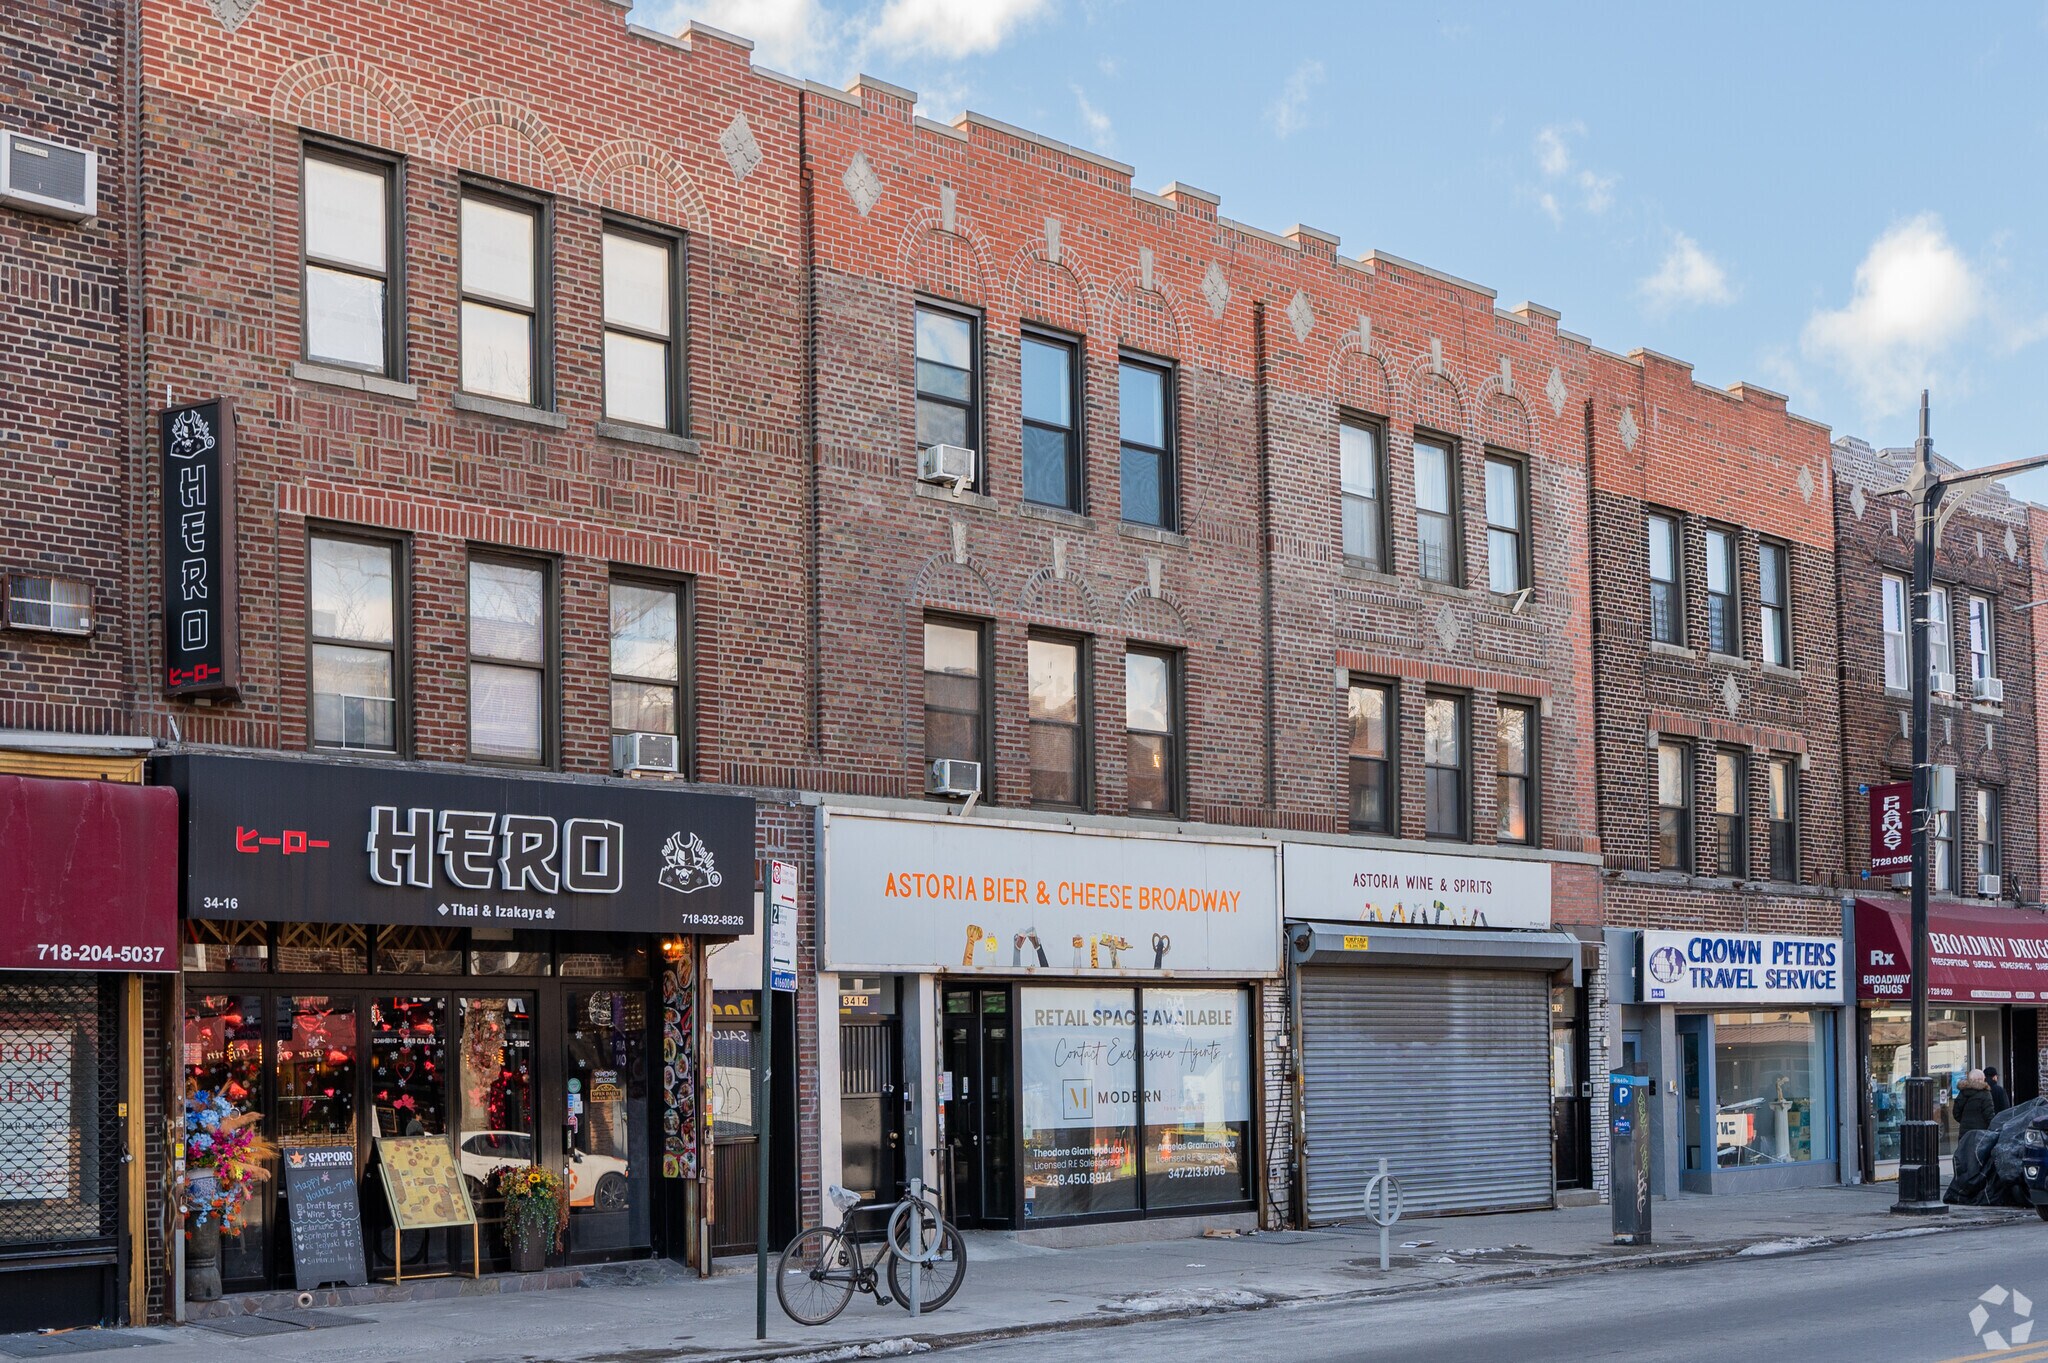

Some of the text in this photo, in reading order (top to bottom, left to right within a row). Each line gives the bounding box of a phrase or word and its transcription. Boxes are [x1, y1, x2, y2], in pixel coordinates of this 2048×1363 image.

[180, 464, 208, 652] HERO
[169, 663, 220, 685] ヒーロー
[1881, 795, 1903, 850] PHARMACY
[236, 826, 330, 855] ヒーロー
[366, 805, 624, 895] HERO
[1353, 873, 1492, 894] ASTORIA WINE & SPIRITS
[885, 872, 1241, 913] ASTORIA BIER & CHEESE BROADWAY
[203, 897, 239, 910] 34-16
[451, 904, 543, 919] Thai & Izakaya
[682, 913, 744, 926] 718-932-8826
[773, 905, 778, 922] 2
[1688, 937, 1836, 966] CROWN PETERS
[1928, 932, 2006, 957] BROADWAY
[37, 943, 165, 963] 718-204-5037
[1871, 950, 1895, 966] Rx
[1689, 967, 1836, 990] TRAVEL SERVICE
[1863, 974, 1911, 985] BROADWAY
[1873, 984, 1903, 994] DRUGS
[843, 996, 868, 1006] 3414
[1035, 1009, 1089, 1026] RETAIL
[1093, 1009, 1148, 1026] SPACE
[1054, 1037, 1221, 1072] Contact Exclusive Agents
[0, 1081, 65, 1102] ENT
[1619, 1087, 1629, 1103] P
[1033, 1146, 1124, 1157] Theodore Giannopoulos
[1157, 1143, 1186, 1152] Angelos
[308, 1151, 353, 1163] SAPPORO
[1034, 1161, 1067, 1170] Licensed
[1168, 1165, 1226, 1179] 347.213.8705
[294, 1176, 320, 1192] Happy
[1046, 1172, 1112, 1186] 239.450.8914
[306, 1201, 354, 1211] Draft Beer $5
[331, 1210, 343, 1218] $6
